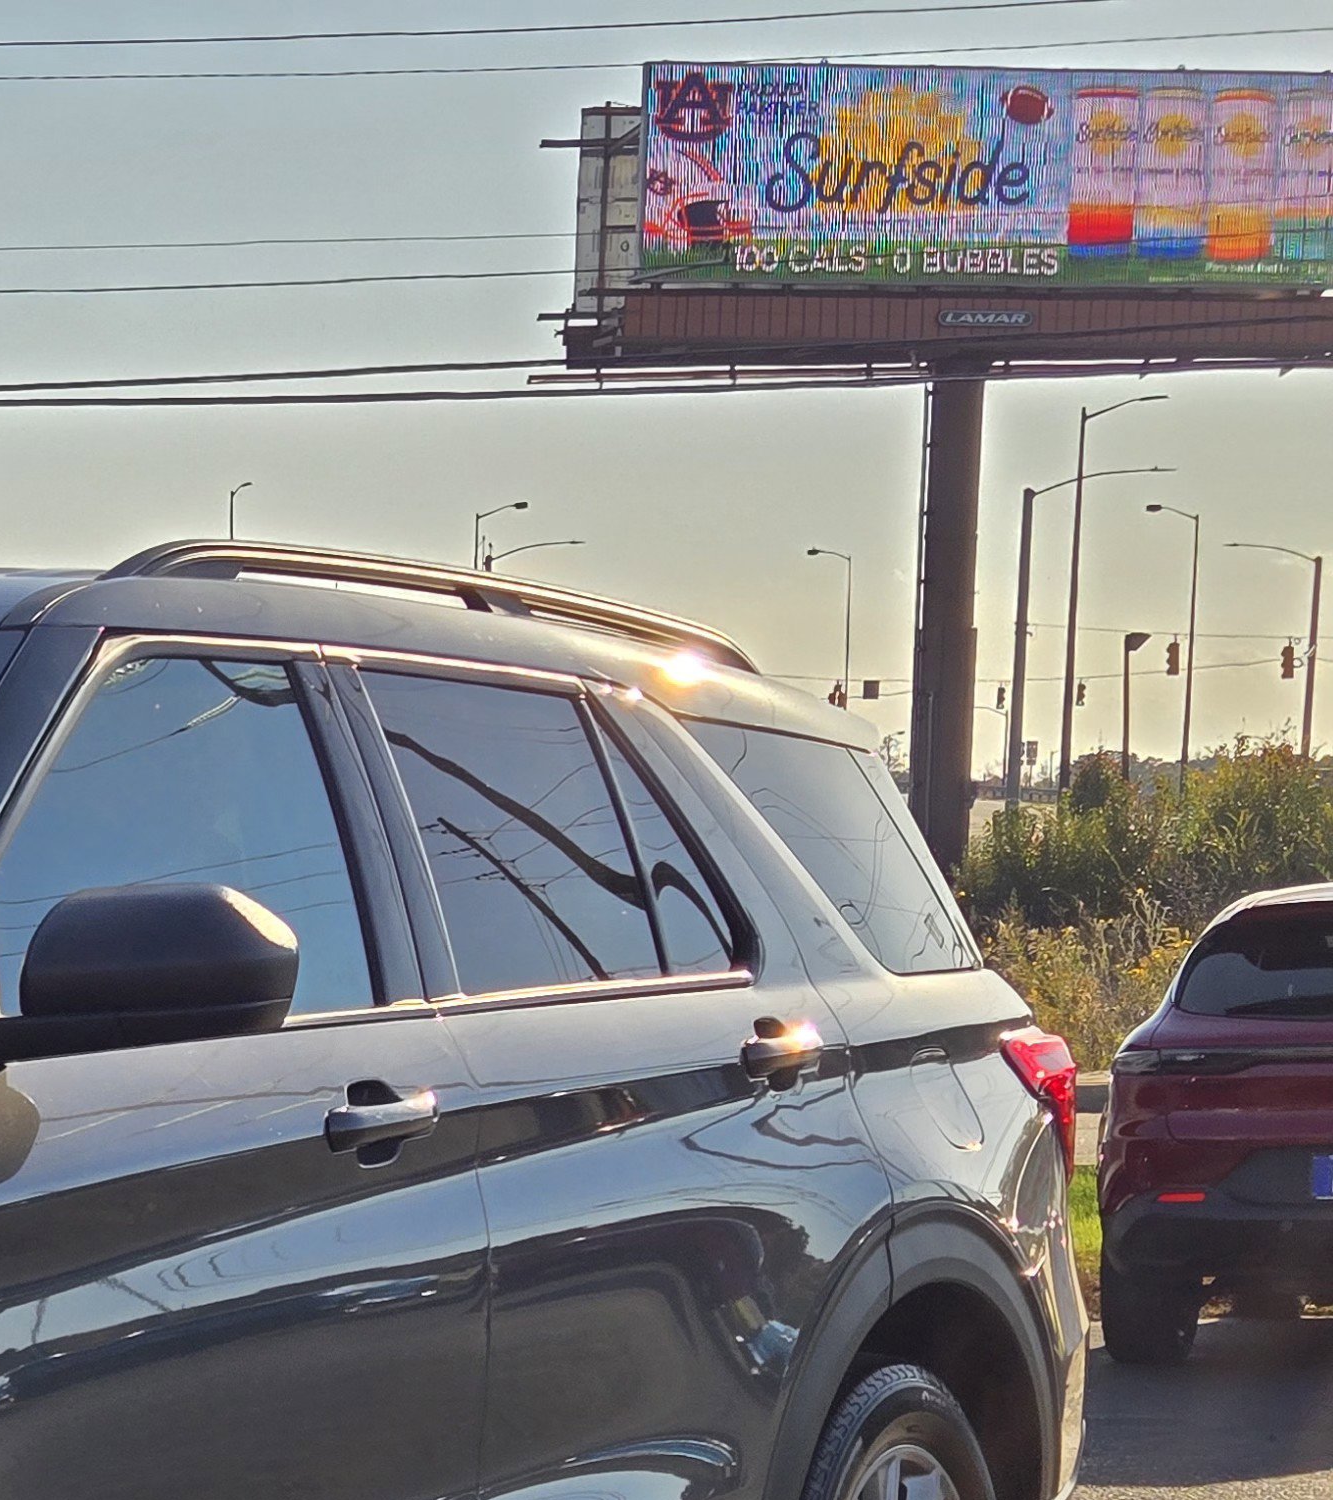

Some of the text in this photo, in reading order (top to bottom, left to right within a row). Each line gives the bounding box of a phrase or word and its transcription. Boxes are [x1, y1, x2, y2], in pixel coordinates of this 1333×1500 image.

[766, 131, 1031, 214] Surfside
[734, 245, 1058, 276] 100 CALS 0 BUBBLES
[944, 311, 1027, 324] LAMAR
